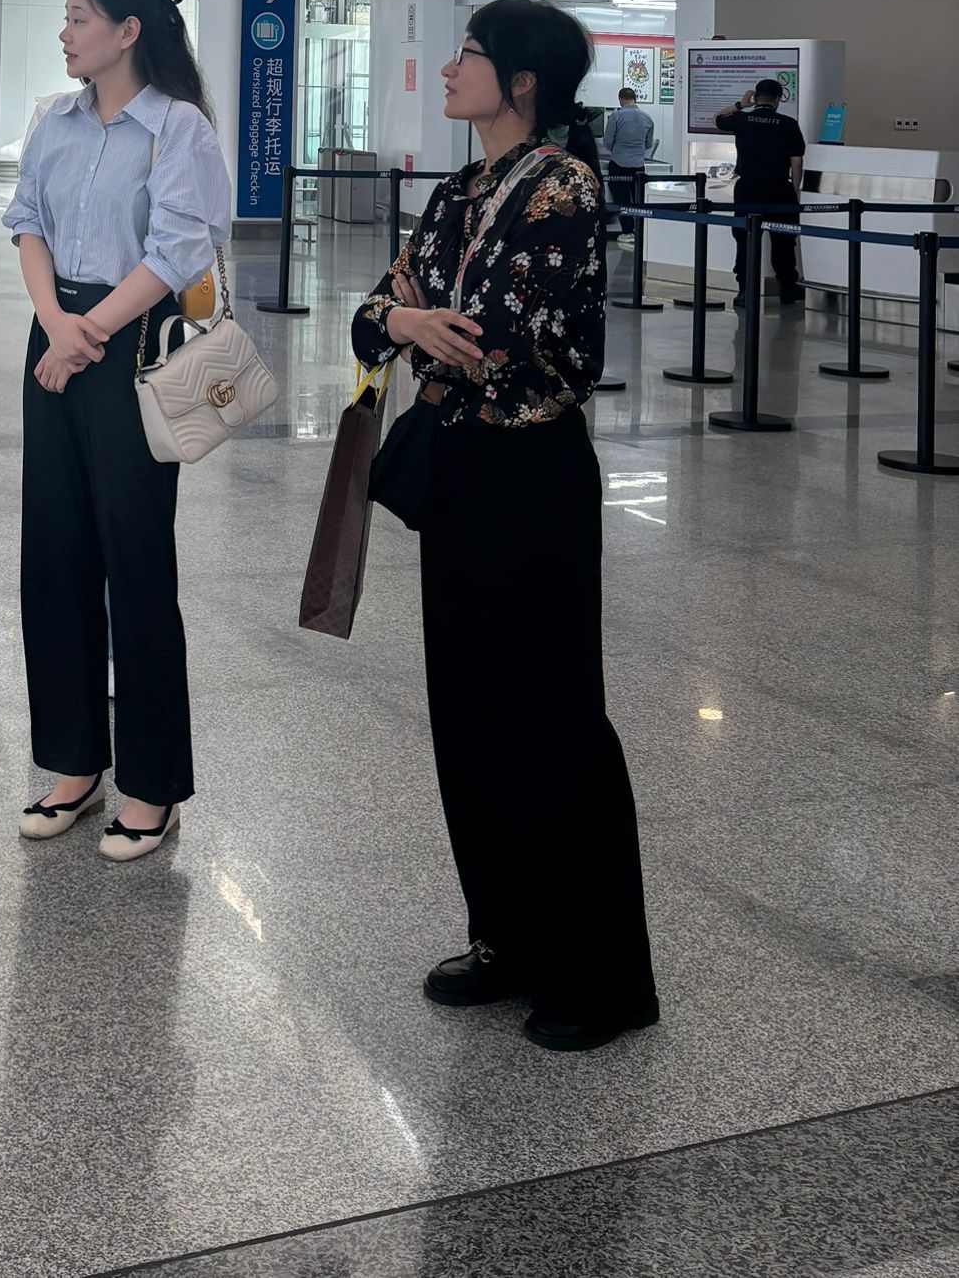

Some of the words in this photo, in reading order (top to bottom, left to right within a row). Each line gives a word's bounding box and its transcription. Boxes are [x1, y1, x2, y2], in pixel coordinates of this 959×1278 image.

[251, 57, 263, 108] Oversized
[248, 111, 262, 158] Baggage
[264, 57, 284, 176] 超规行李托运
[249, 160, 261, 206] Check-in
